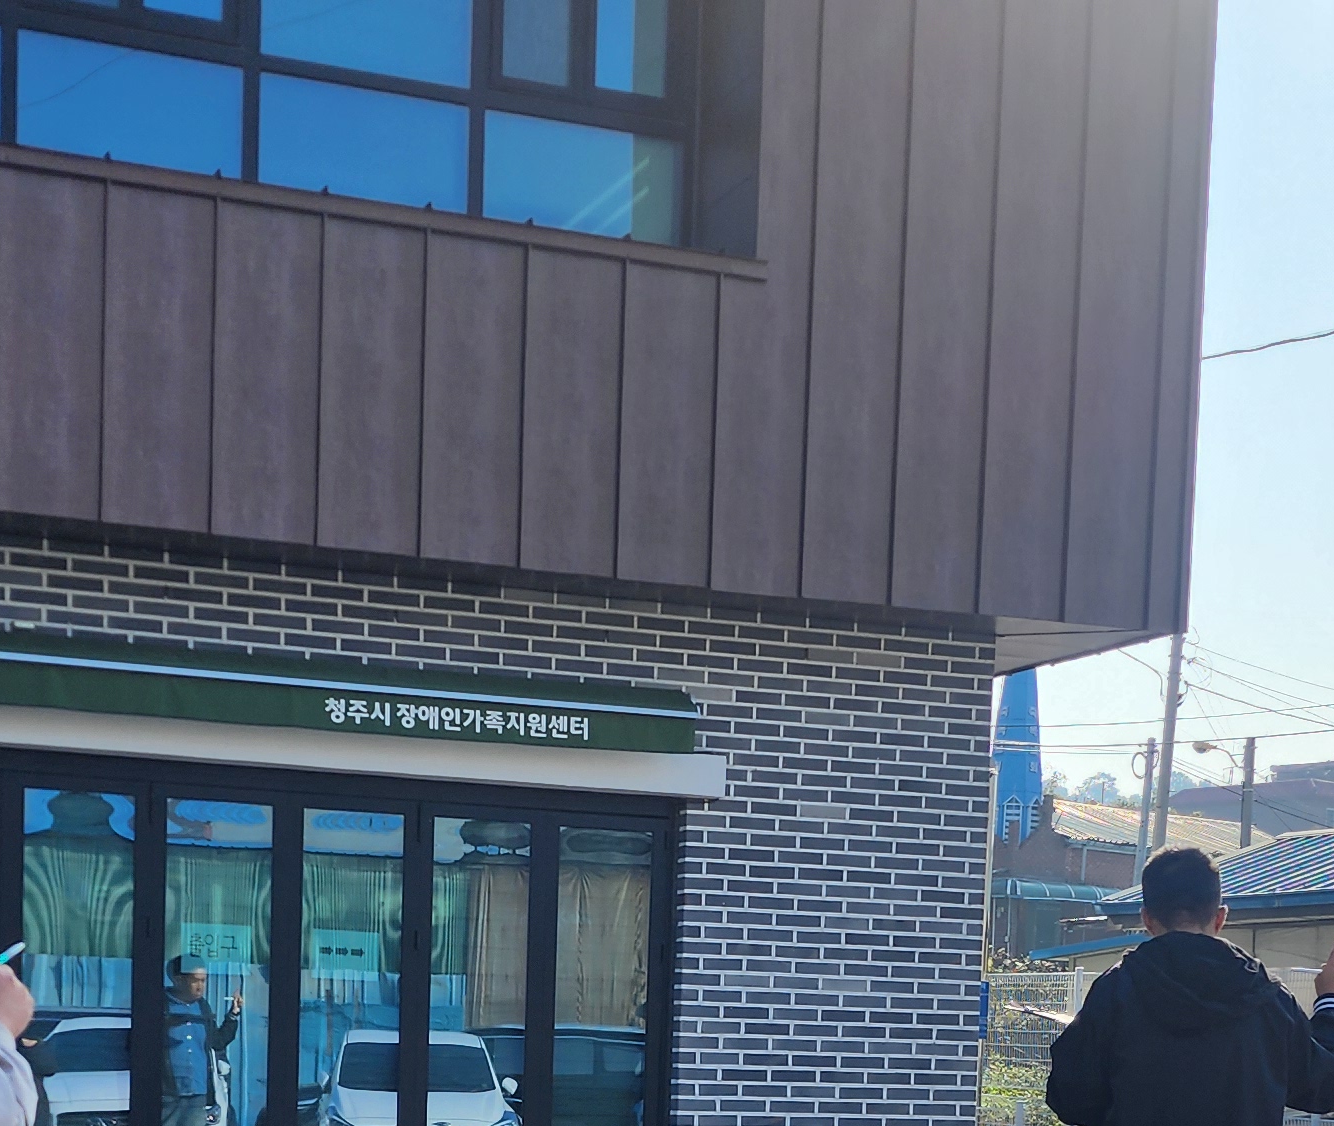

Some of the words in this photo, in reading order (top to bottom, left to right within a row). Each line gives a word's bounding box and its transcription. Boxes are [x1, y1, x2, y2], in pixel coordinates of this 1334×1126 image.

[325, 698, 390, 726] 청주시
[396, 703, 589, 740] 장애인가족지원센터
[190, 933, 238, 957] 출입구
